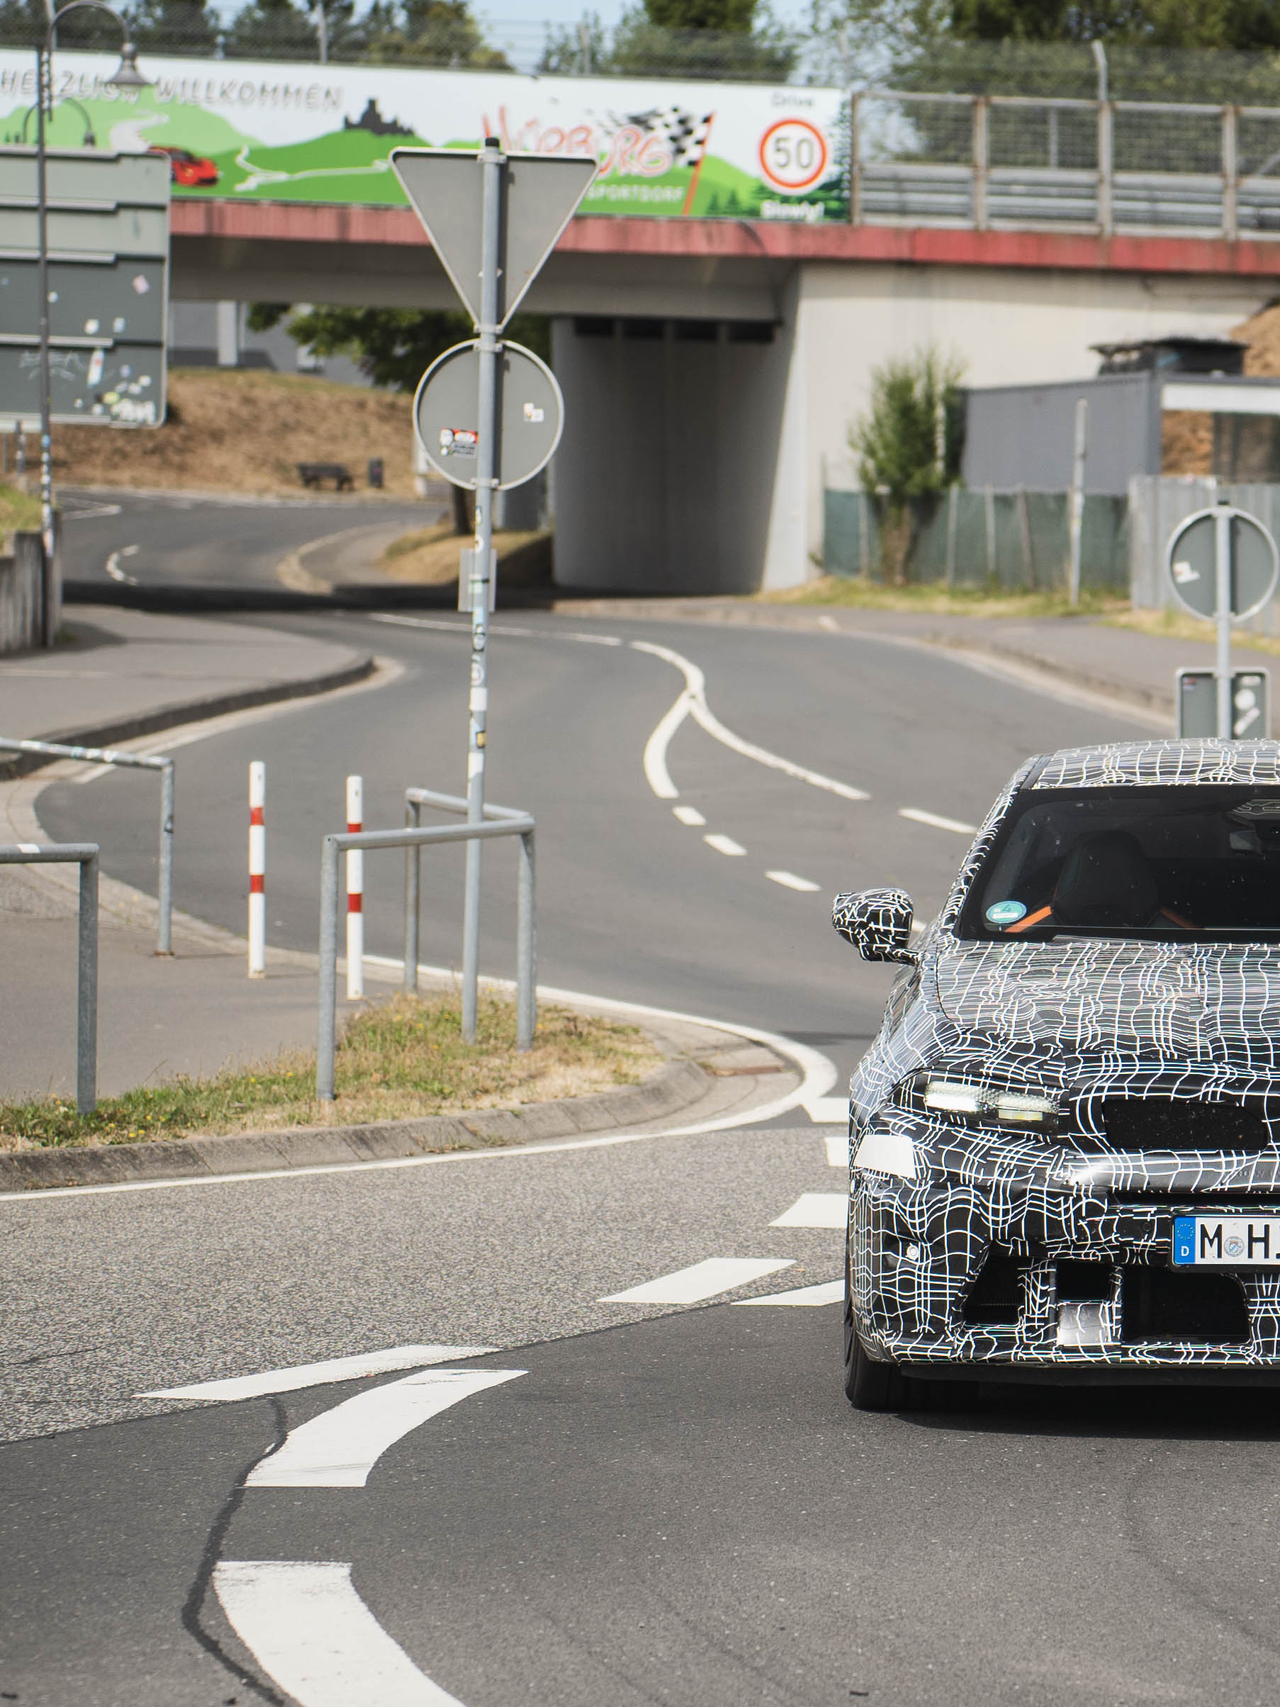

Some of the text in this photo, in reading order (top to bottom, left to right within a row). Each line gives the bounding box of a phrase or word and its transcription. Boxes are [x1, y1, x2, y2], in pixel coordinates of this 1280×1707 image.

[1, 68, 343, 112] HEZLIC WILLKOMMEN
[772, 92, 815, 107] Drive
[775, 137, 814, 168] 50
[1180, 1246, 1190, 1257] D
[1200, 1224, 1223, 1259] M
